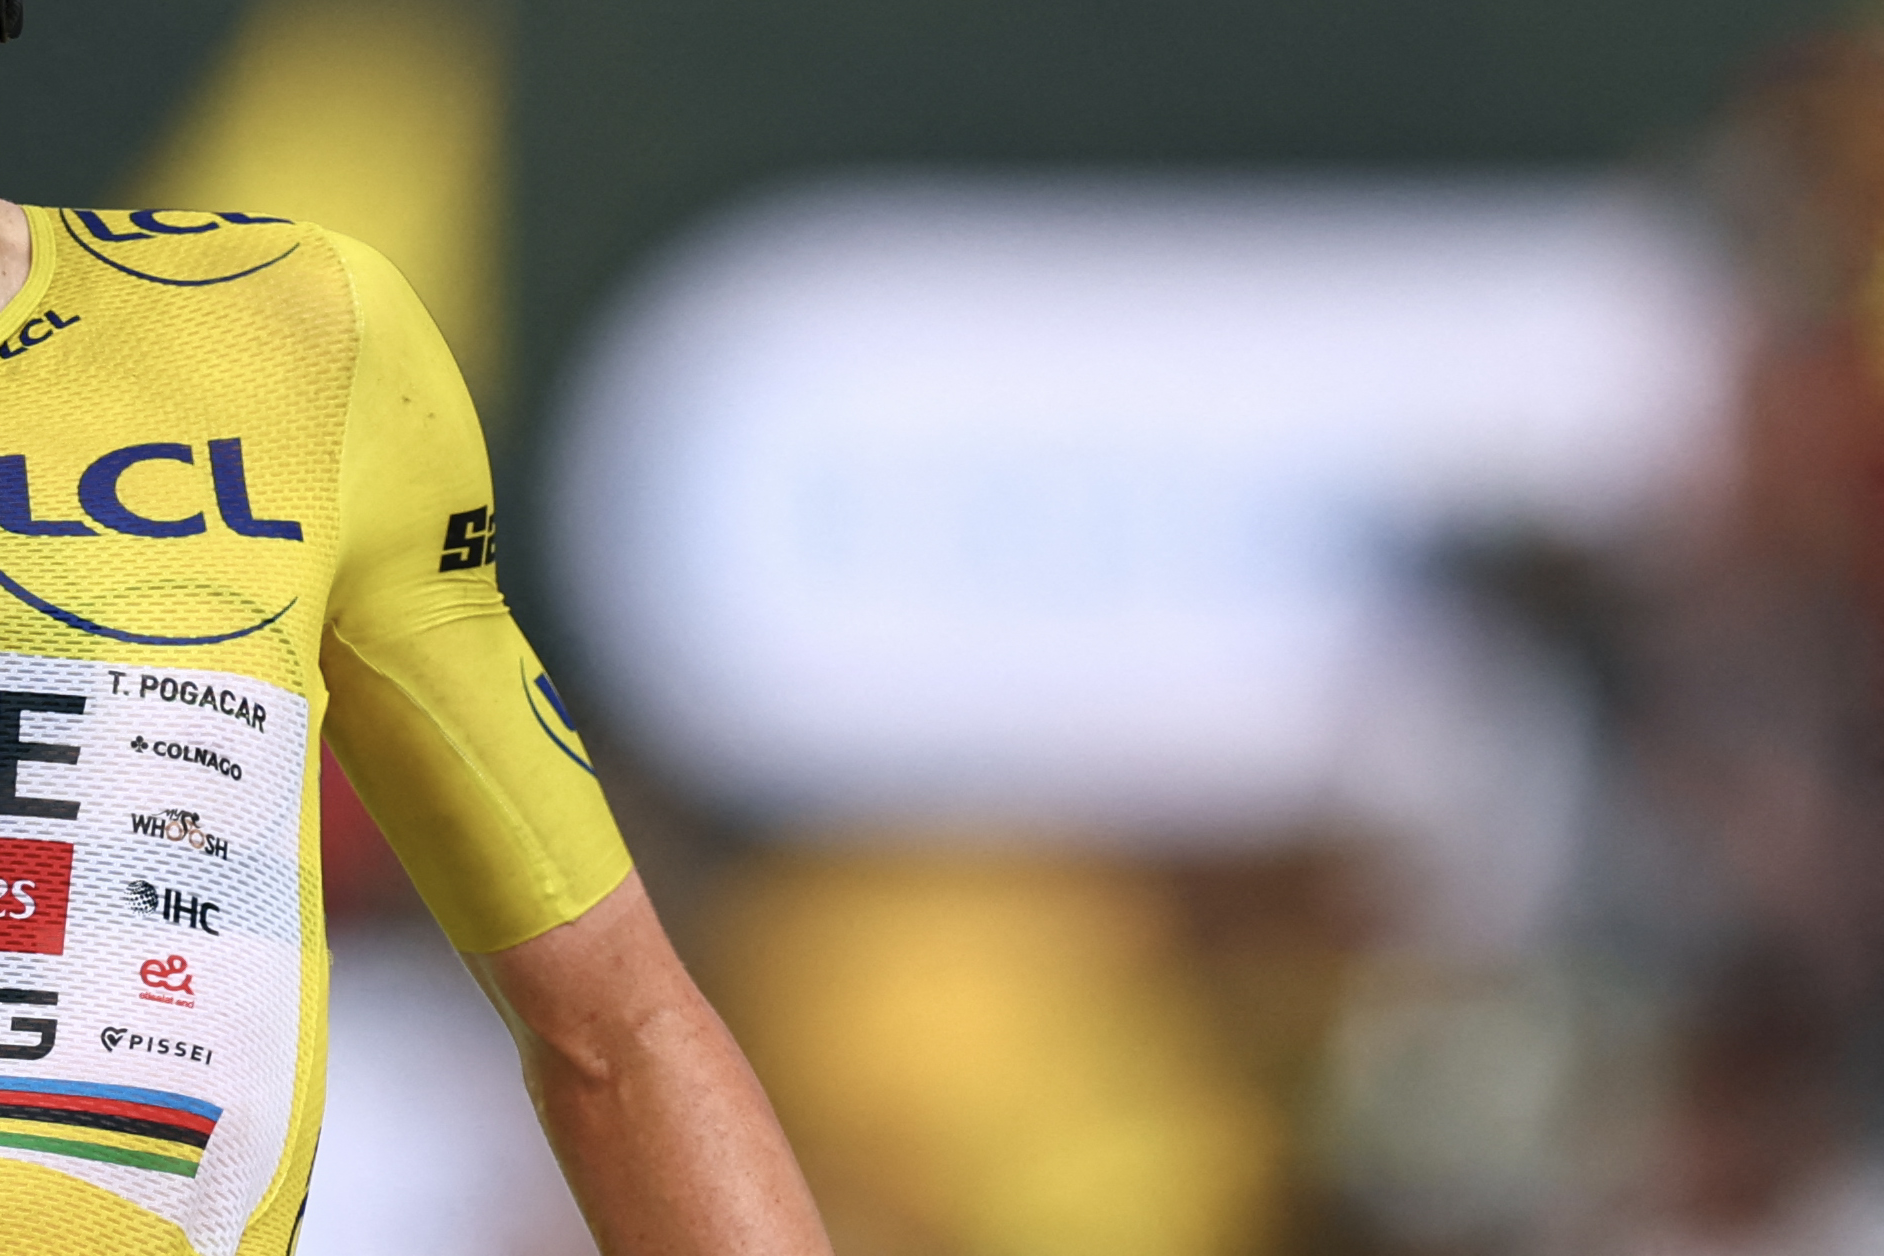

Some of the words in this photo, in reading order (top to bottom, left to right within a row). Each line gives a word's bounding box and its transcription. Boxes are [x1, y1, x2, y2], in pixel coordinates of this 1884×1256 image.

[108, 670, 130, 696] T.
[139, 673, 267, 734] POGACAR
[152, 740, 243, 781] COLNAGO
[162, 887, 221, 937] IHC
[128, 1033, 213, 1066] PISSEI
